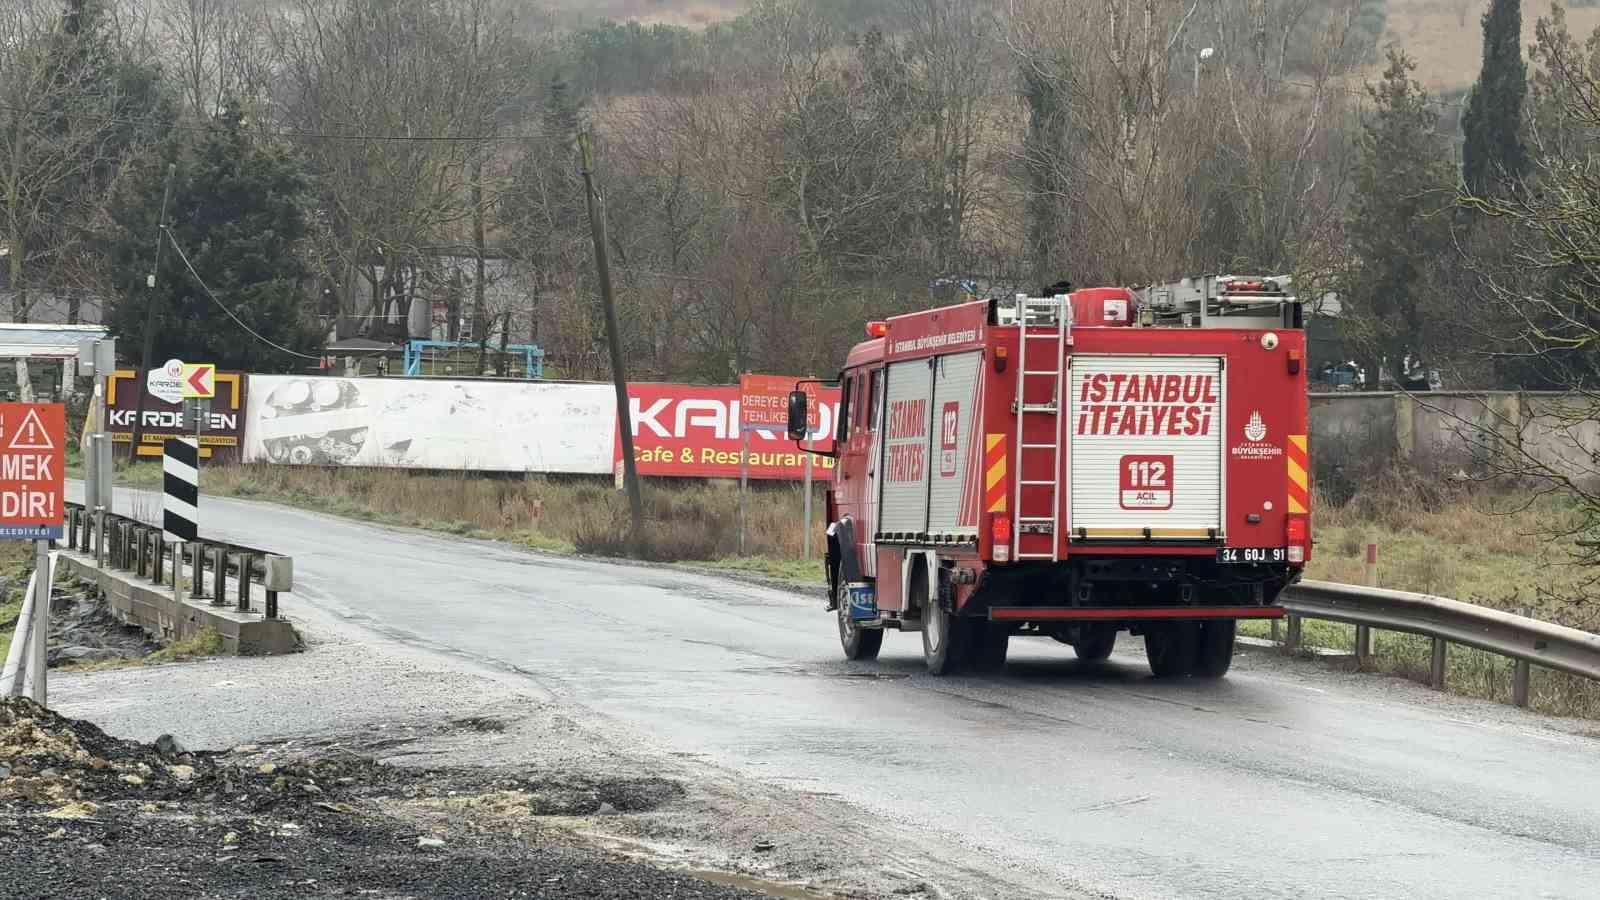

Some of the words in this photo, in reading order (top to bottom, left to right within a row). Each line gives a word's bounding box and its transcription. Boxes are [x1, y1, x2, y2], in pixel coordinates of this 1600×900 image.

[742, 395, 779, 408] DEREYE
[109, 409, 237, 430] KARDEEN
[944, 410, 957, 444] 112
[633, 446, 673, 463] Cafe
[680, 448, 694, 463] &
[0, 454, 53, 480] MEK
[1128, 461, 1167, 487] 112
[2, 484, 56, 518] DİR!
[1223, 549, 1237, 561] 34
[1245, 549, 1265, 561] GOJ
[1273, 549, 1285, 561] 91
